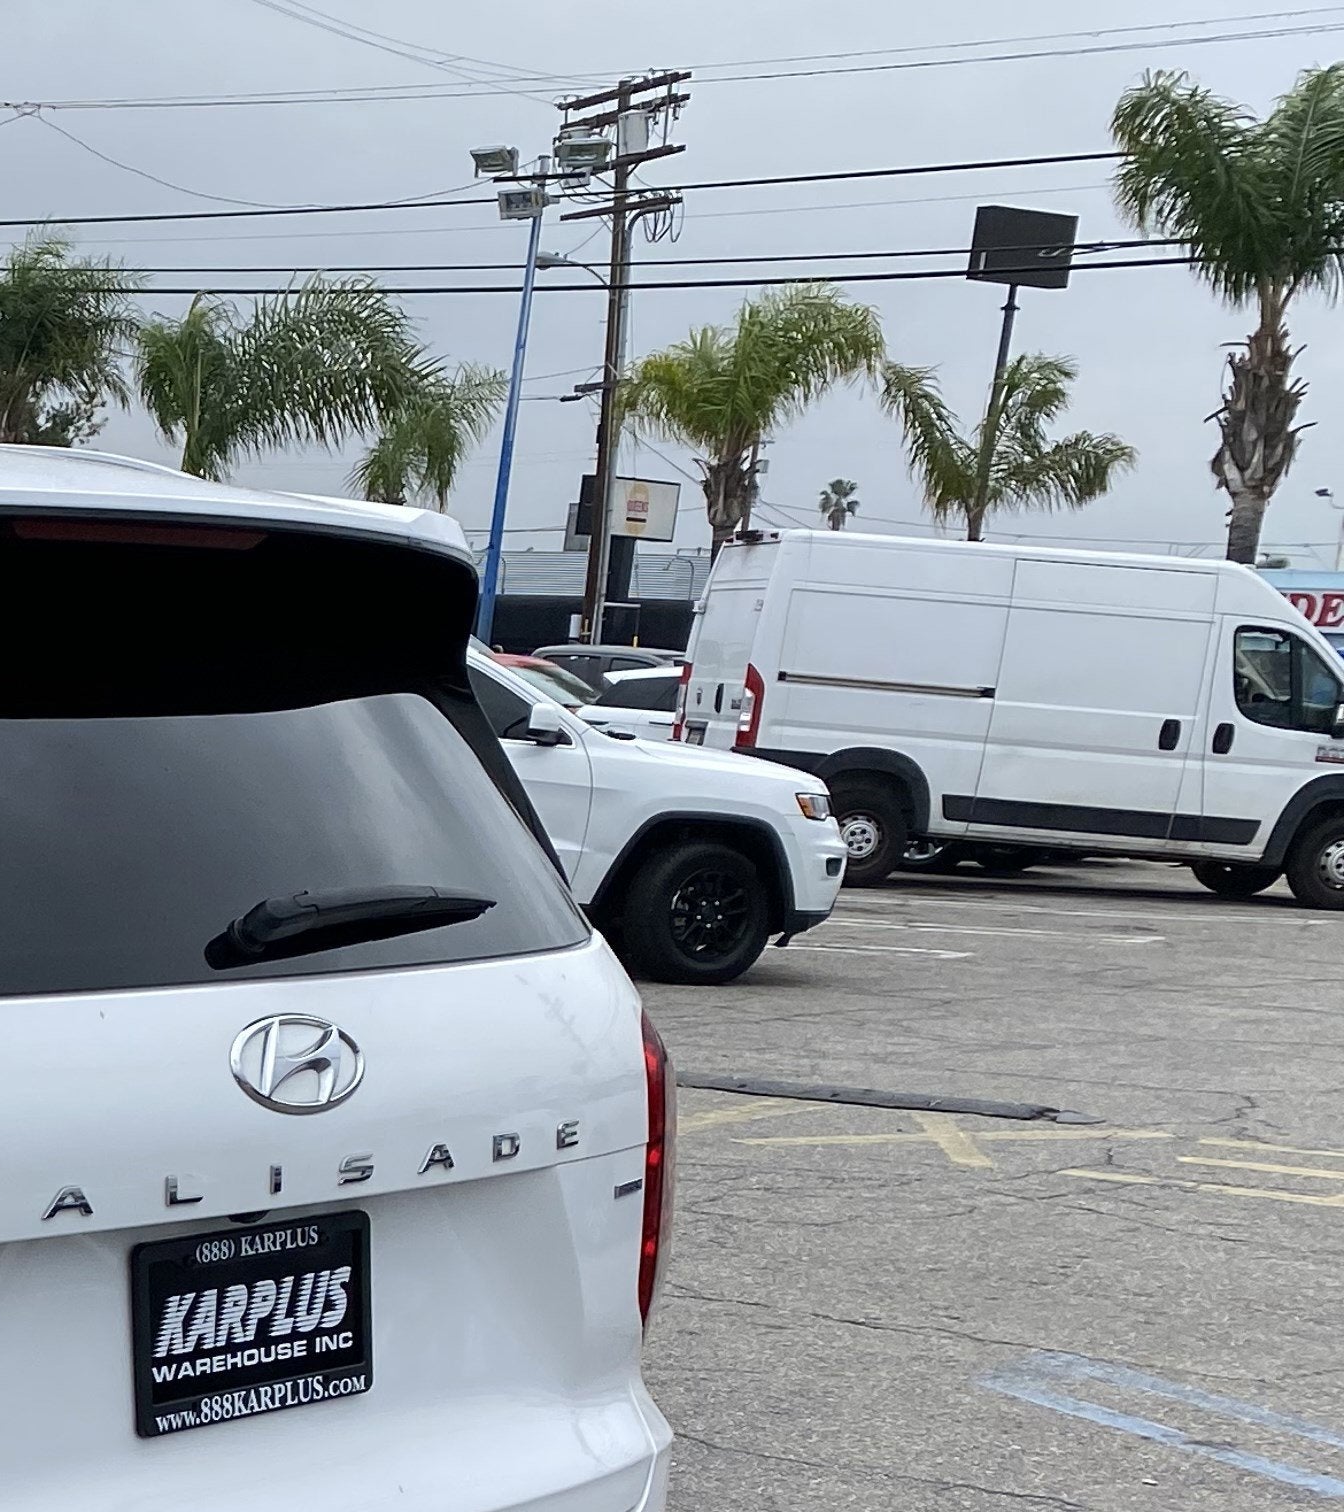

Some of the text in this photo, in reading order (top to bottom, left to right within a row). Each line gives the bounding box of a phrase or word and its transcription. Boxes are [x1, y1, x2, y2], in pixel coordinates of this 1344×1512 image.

[195, 1225, 319, 1264] (888) KARPLUS
[152, 1265, 352, 1358] KARPLUS
[152, 1331, 354, 1383] WAREHOUSE INC
